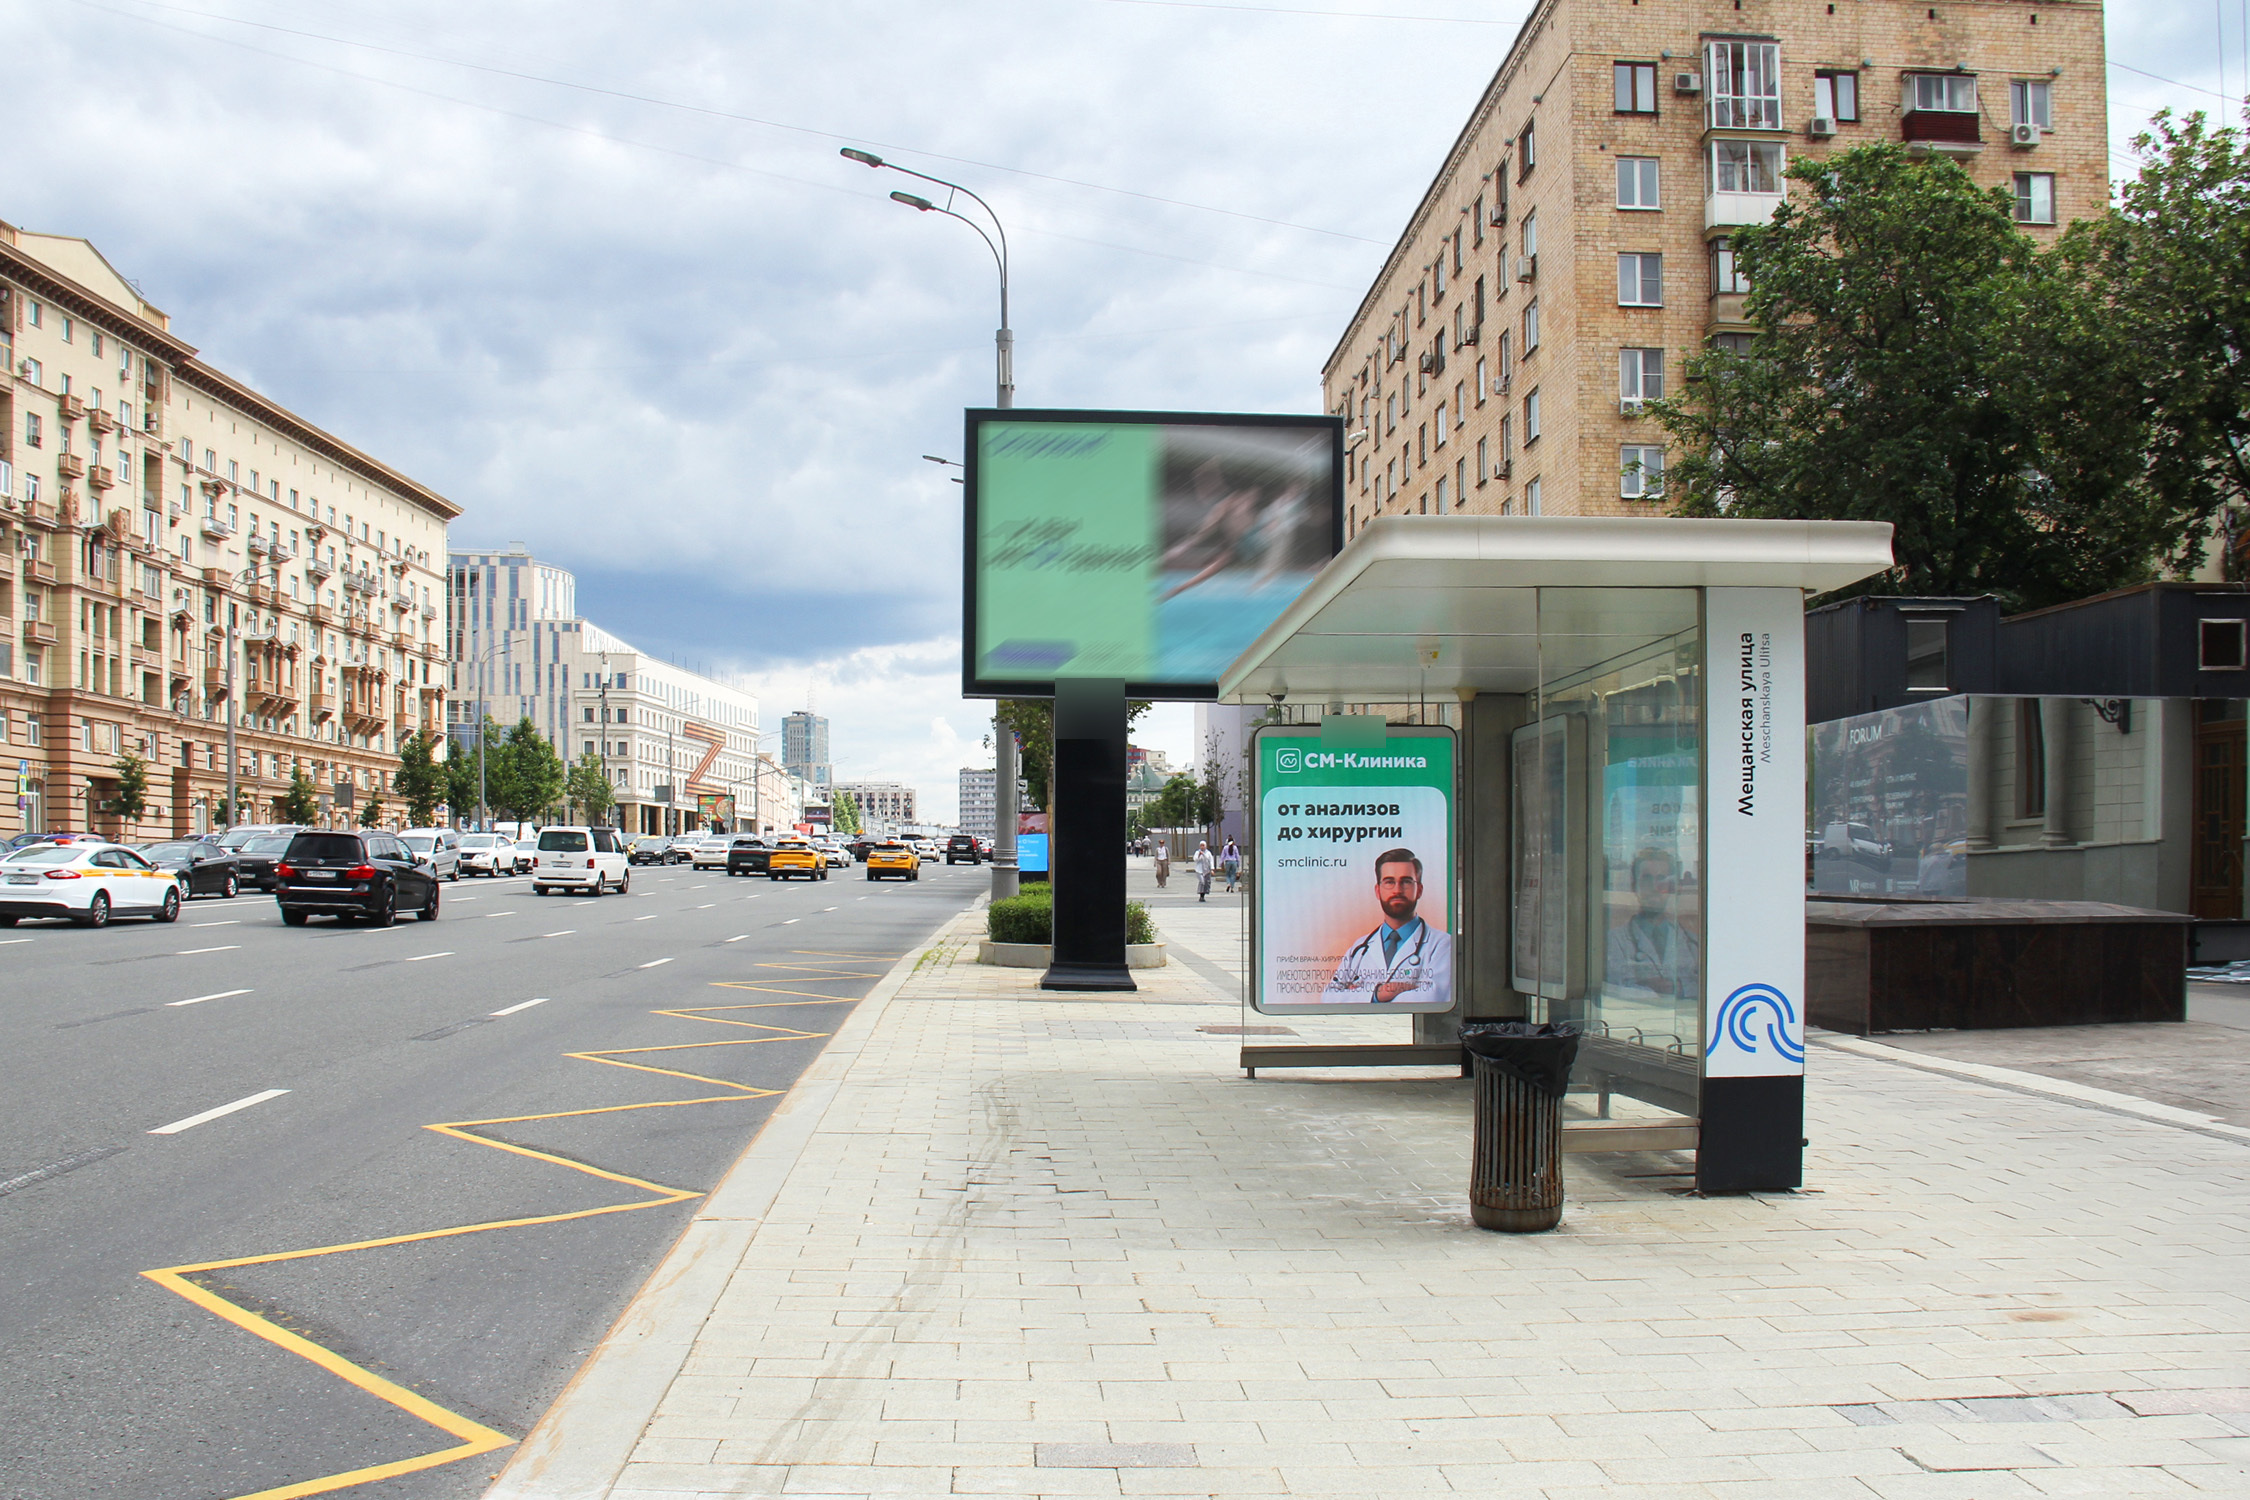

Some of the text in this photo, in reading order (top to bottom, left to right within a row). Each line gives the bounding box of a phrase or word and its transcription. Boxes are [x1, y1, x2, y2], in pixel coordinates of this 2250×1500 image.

[1759, 632, 1773, 764] Meschanskaya Ulitsa
[1738, 632, 1757, 817] Мещанская улица
[1849, 724, 1882, 745] FORUM
[1304, 752, 1427, 769] СМ-Клиника
[1277, 804, 1400, 816] от анализов
[1277, 826, 1402, 843] до хирургии
[1277, 856, 1347, 868] smclinic.ru
[1276, 954, 1349, 963] ПРИЁМ ВРАЧА-ХИРУРГА
[1276, 969, 1310, 981] ИМЕЮТСЯ
